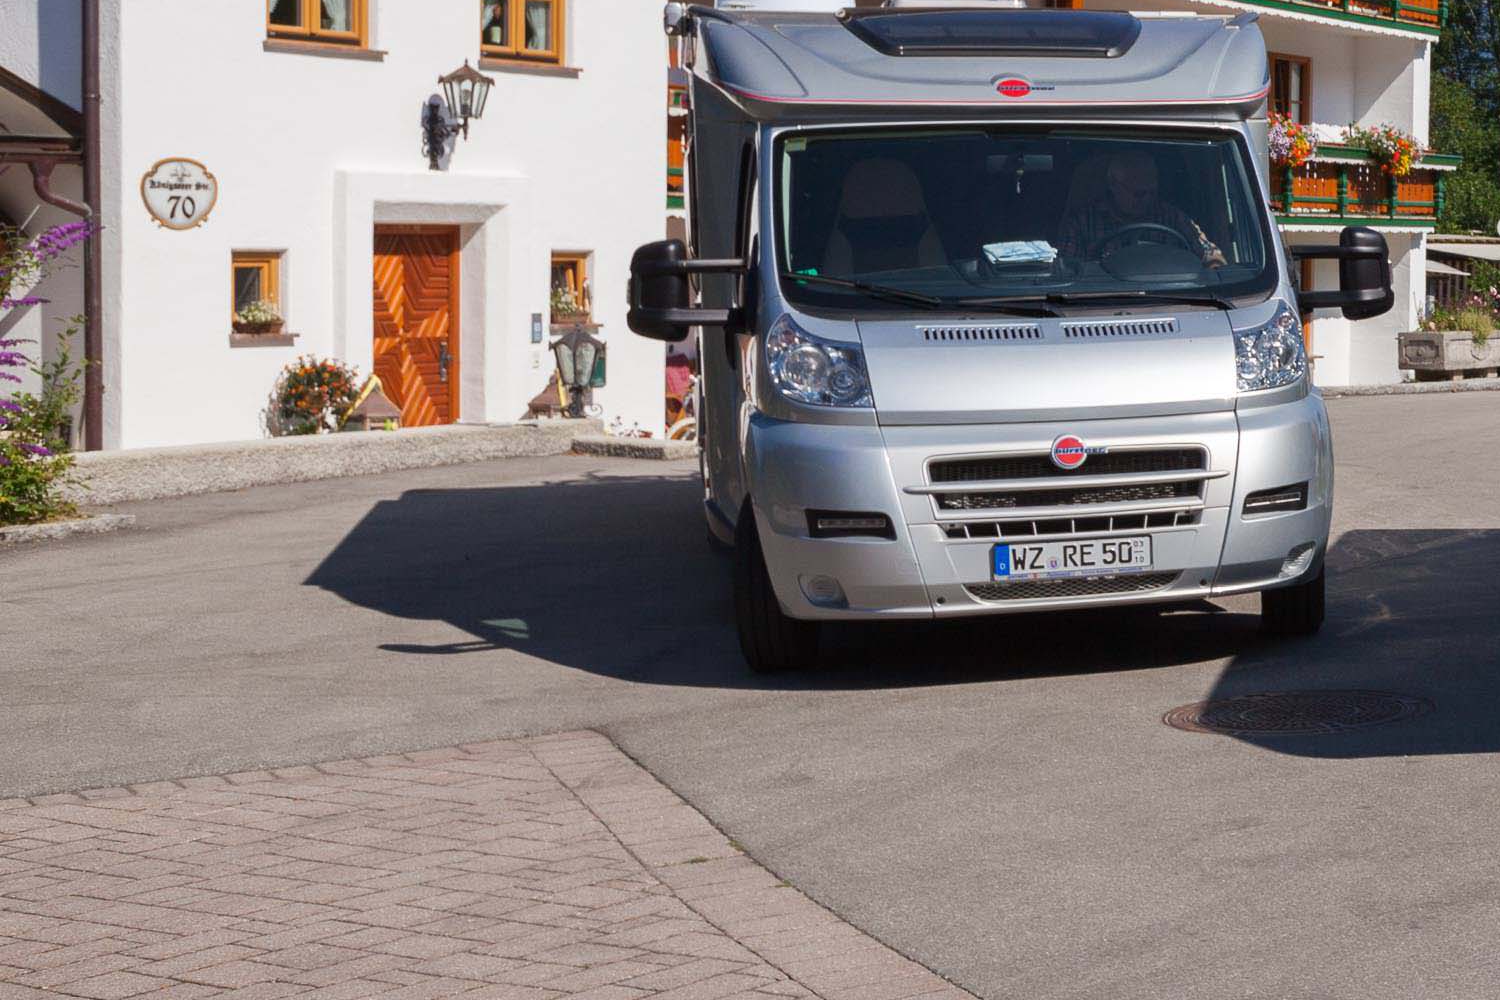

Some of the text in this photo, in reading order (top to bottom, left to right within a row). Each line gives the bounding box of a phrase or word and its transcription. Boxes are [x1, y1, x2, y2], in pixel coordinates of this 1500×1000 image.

[168, 196, 195, 219] 70
[1012, 547, 1045, 571] WZ
[1063, 544, 1095, 567] RE
[1102, 541, 1132, 564] 50
